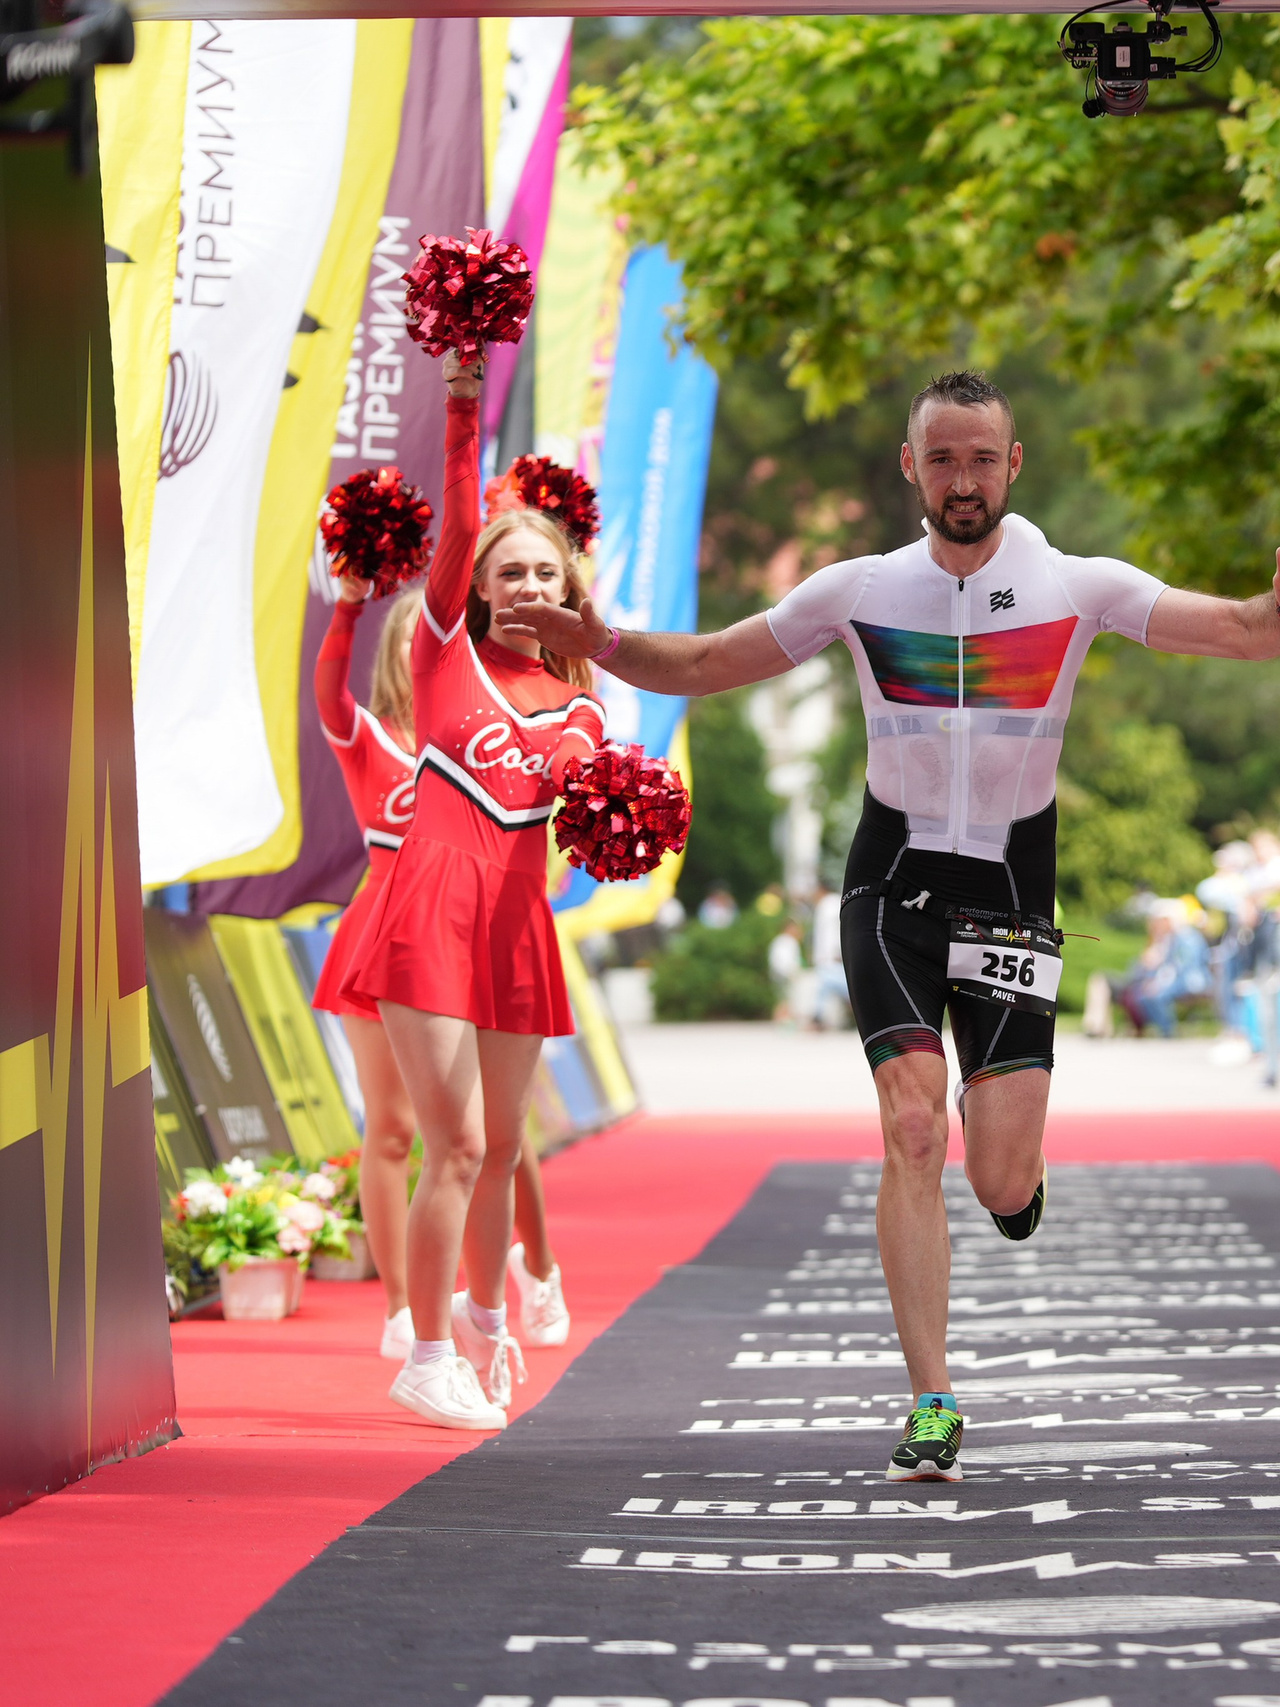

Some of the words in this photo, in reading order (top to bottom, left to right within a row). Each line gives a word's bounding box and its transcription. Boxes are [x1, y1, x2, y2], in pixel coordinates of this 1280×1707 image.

[190, 19, 235, 307] ПРЕМИУМ
[361, 216, 411, 461] ПРЕМИУМ
[959, 907, 1009, 918] performance
[966, 912, 994, 921] recovery
[992, 927, 1009, 937] IRON
[981, 951, 1035, 987] 256
[991, 988, 1016, 1003] PAVEL
[622, 1498, 961, 1514] IRON
[577, 1547, 953, 1569] IRON
